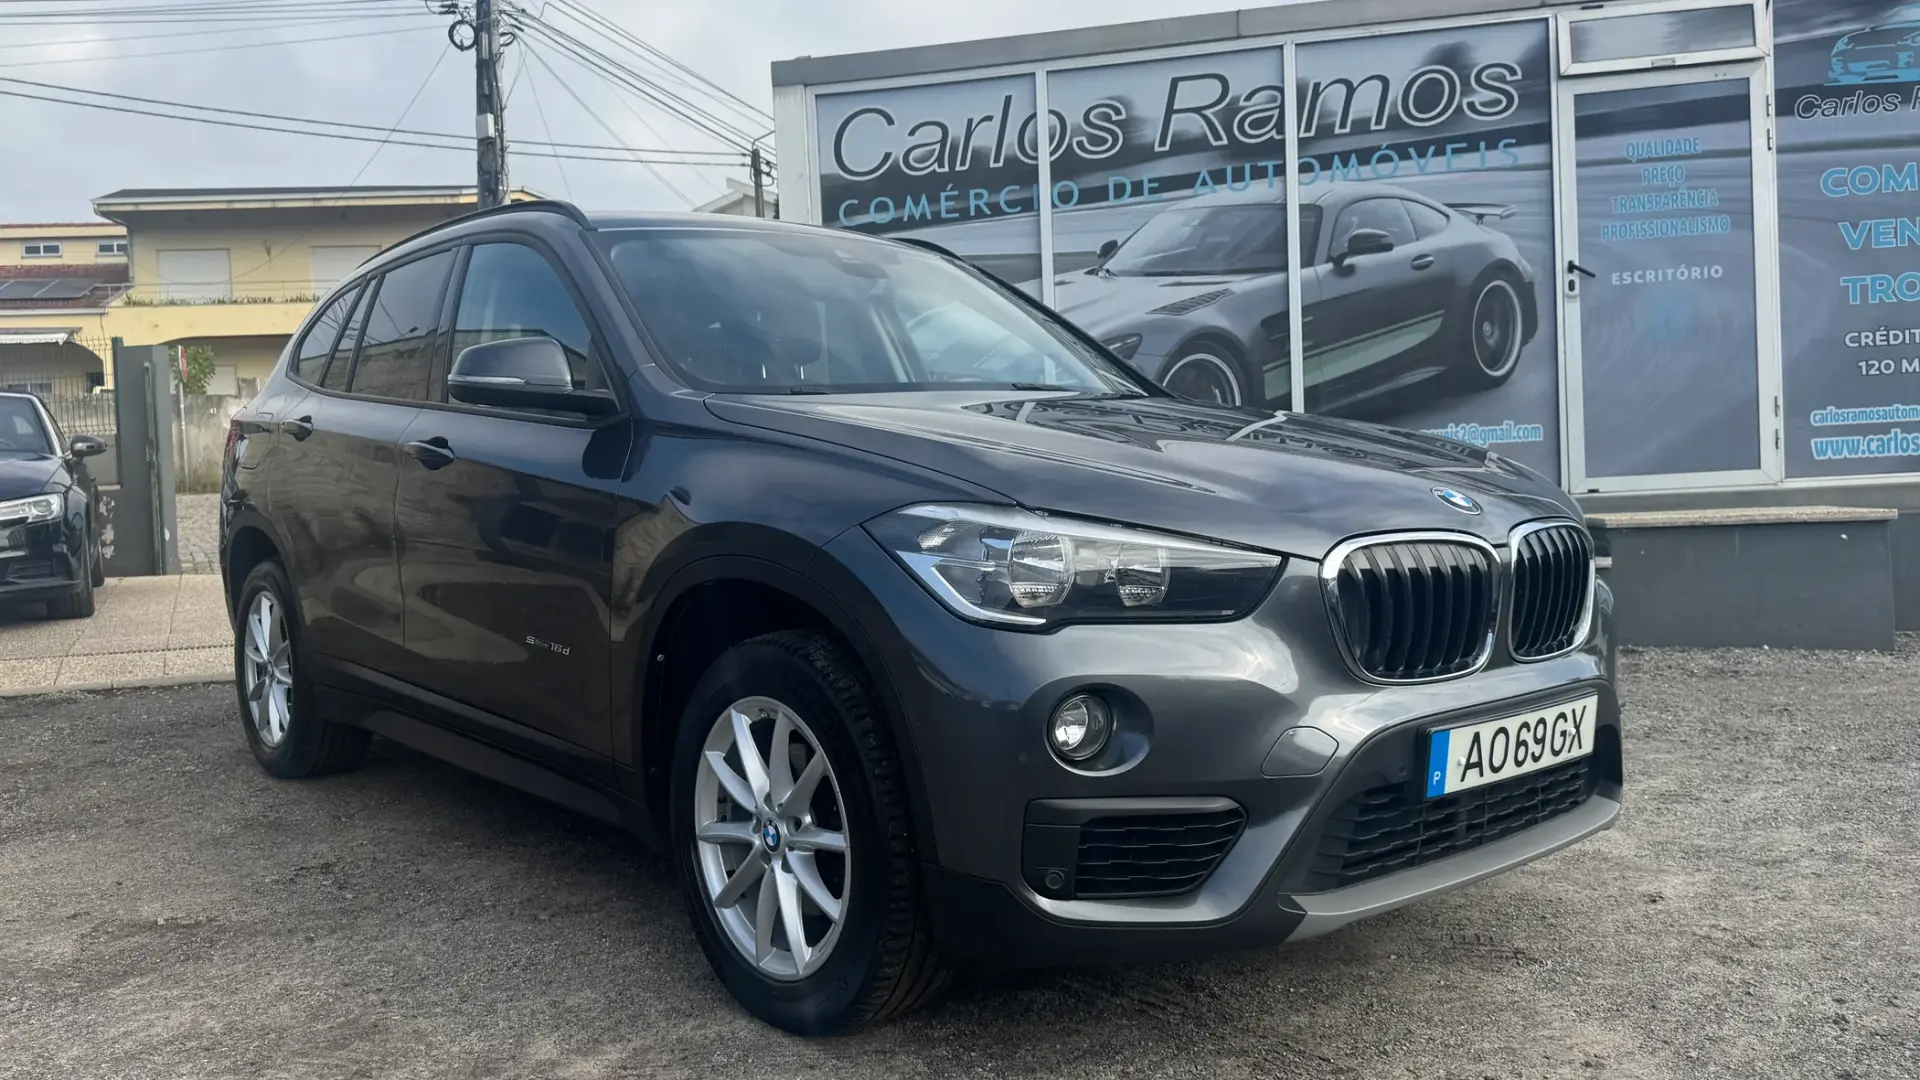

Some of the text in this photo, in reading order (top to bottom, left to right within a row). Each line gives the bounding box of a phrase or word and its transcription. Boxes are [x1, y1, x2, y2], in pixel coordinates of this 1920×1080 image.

[1795, 90, 1901, 120] Carlos
[833, 61, 1522, 180] Carlos Ramos
[1625, 137, 1701, 162] QUALIDADE
[838, 138, 1519, 226] COMÉRCIO DE AUTOMÓVEIS
[1641, 164, 1686, 187] PREÇO
[1820, 162, 1919, 198] COM
[1610, 186, 1720, 214] TRANSPARÊNCIA
[1600, 214, 1731, 241] PROFISSIONALISMO
[1838, 217, 1920, 250] VEN
[1611, 264, 1724, 285] ESCRITÓRIO
[1840, 271, 1920, 305] TRO
[1858, 359, 1896, 375] 120
[1810, 404, 1920, 426] carlosramosautom
[1811, 428, 1920, 459] www.carlos
[1433, 770, 1441, 785] P
